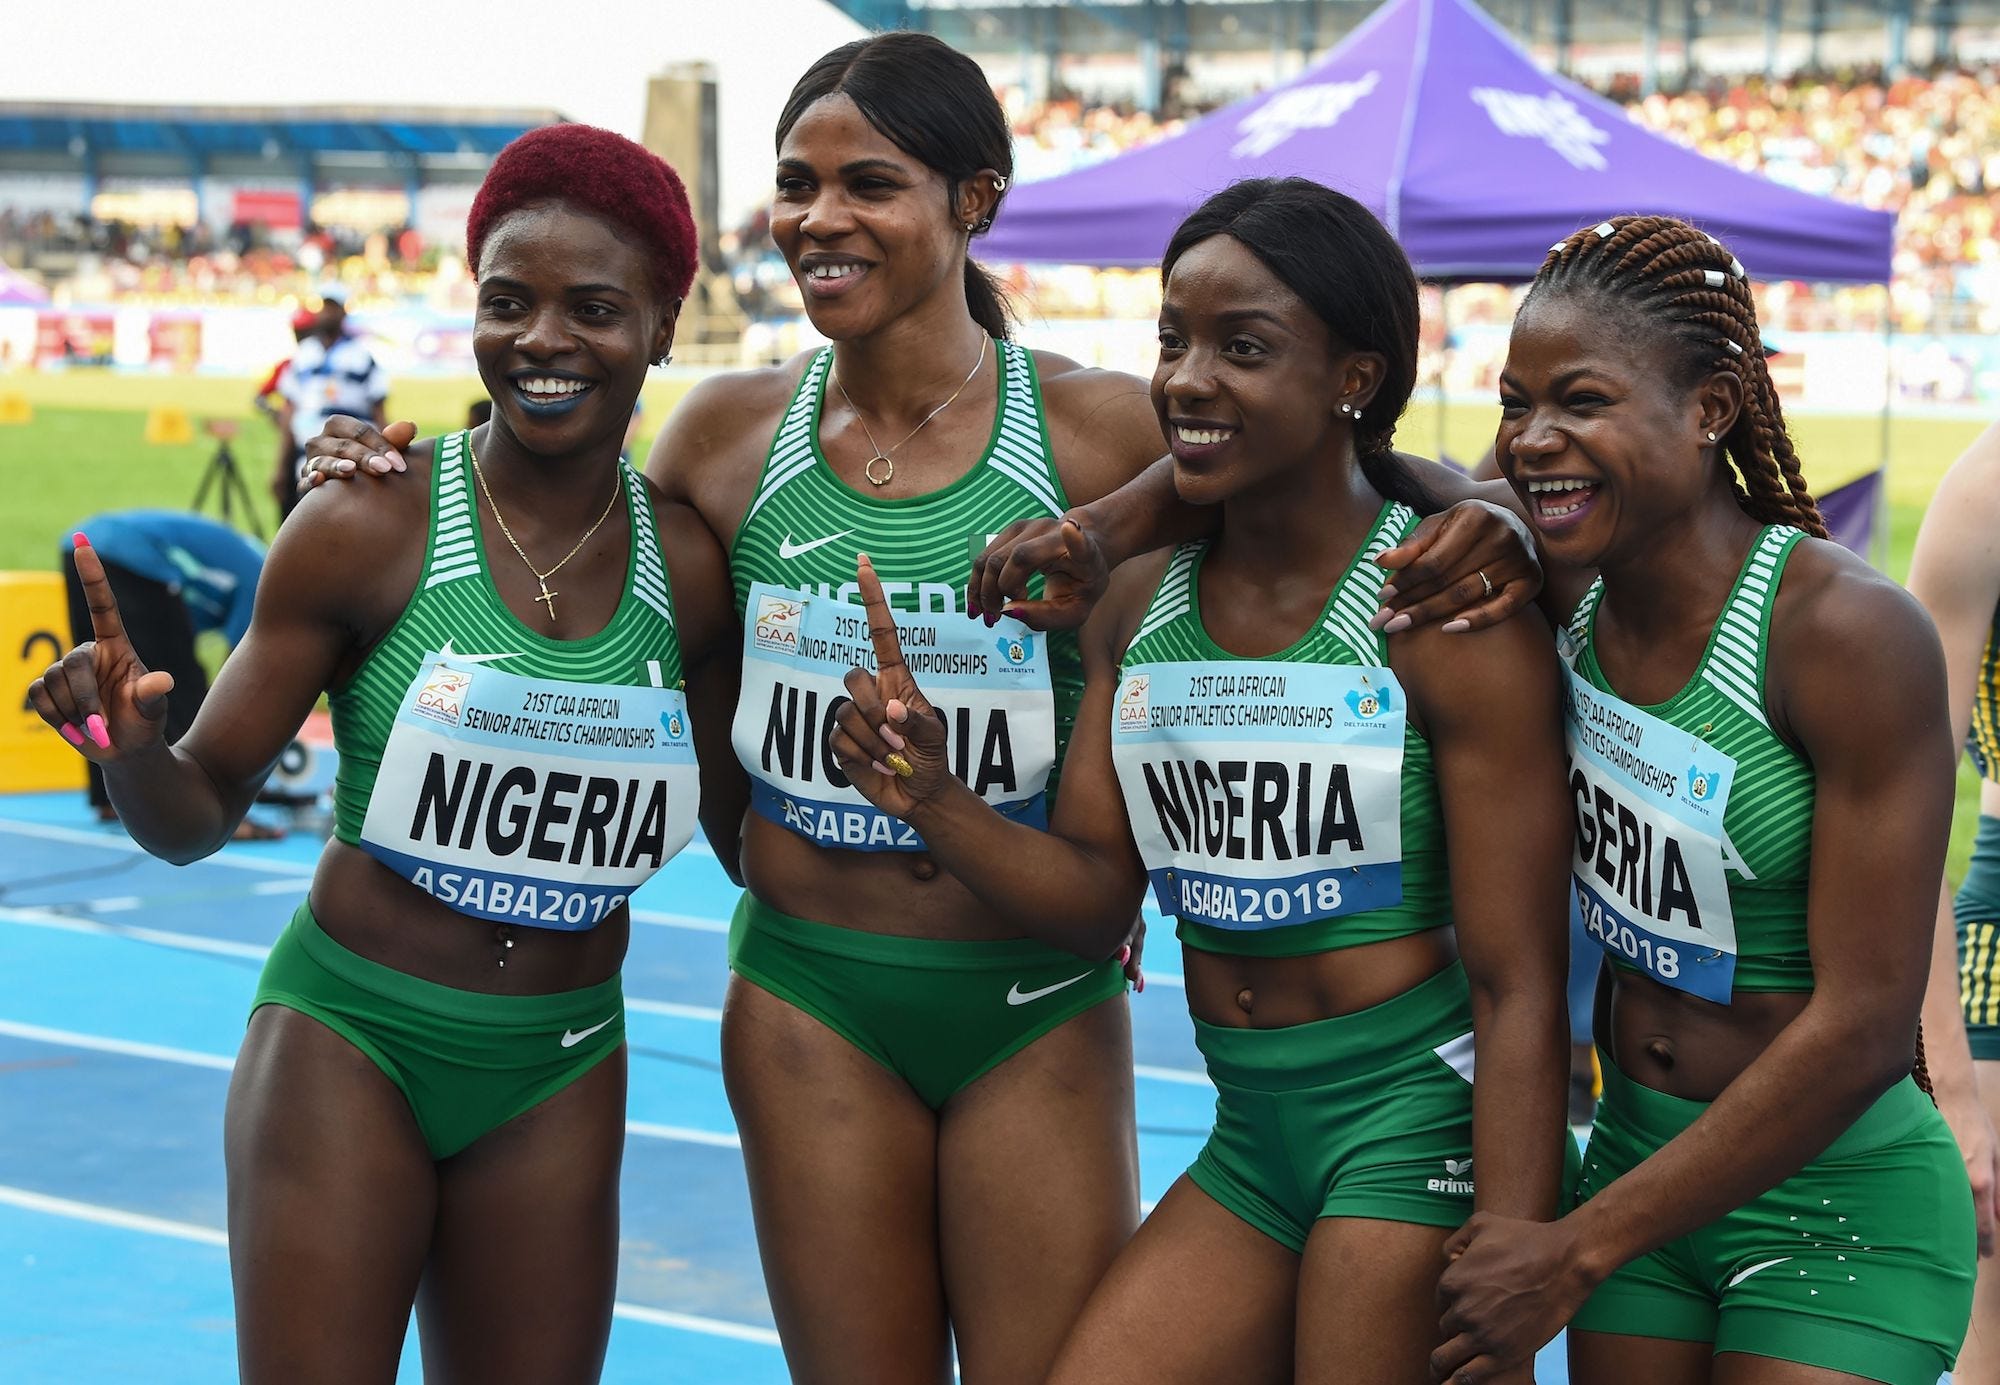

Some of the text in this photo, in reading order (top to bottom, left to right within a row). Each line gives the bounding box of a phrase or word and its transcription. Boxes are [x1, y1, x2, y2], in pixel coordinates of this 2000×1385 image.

[757, 626, 796, 644] CAA
[835, 616, 859, 639] 21ST
[896, 627, 935, 647] RICAN
[798, 635, 827, 660] NIOR
[829, 643, 878, 671] ATHLETIC
[904, 653, 988, 675] AMPIONSHIPS
[419, 692, 459, 716] CAA
[523, 692, 621, 720] 21ST CAA AFRICAN
[1189, 675, 1286, 698] 21ST CAA AFRICAN
[464, 707, 510, 735] SENIOR
[511, 715, 576, 743] ATHLETICS
[573, 724, 655, 749] CHAMPIONSHIPS
[1120, 707, 1147, 720] CAA
[1151, 704, 1333, 729] SENIOR ATHLETICS CHAMPIONSHIPS
[1344, 721, 1387, 729] DELTASTATE
[1606, 710, 1643, 749] AFRICAN
[761, 681, 1017, 797] NIGIA
[1606, 739, 1677, 797] CHAMPIONSHIPS
[409, 752, 667, 869] NIGERIA
[784, 798, 918, 846] ASABA2
[1142, 760, 1364, 861] NIGERIA
[1569, 766, 1702, 929] GERIA
[1182, 877, 1343, 923] ASABA2018
[1578, 888, 1680, 979] BA2018
